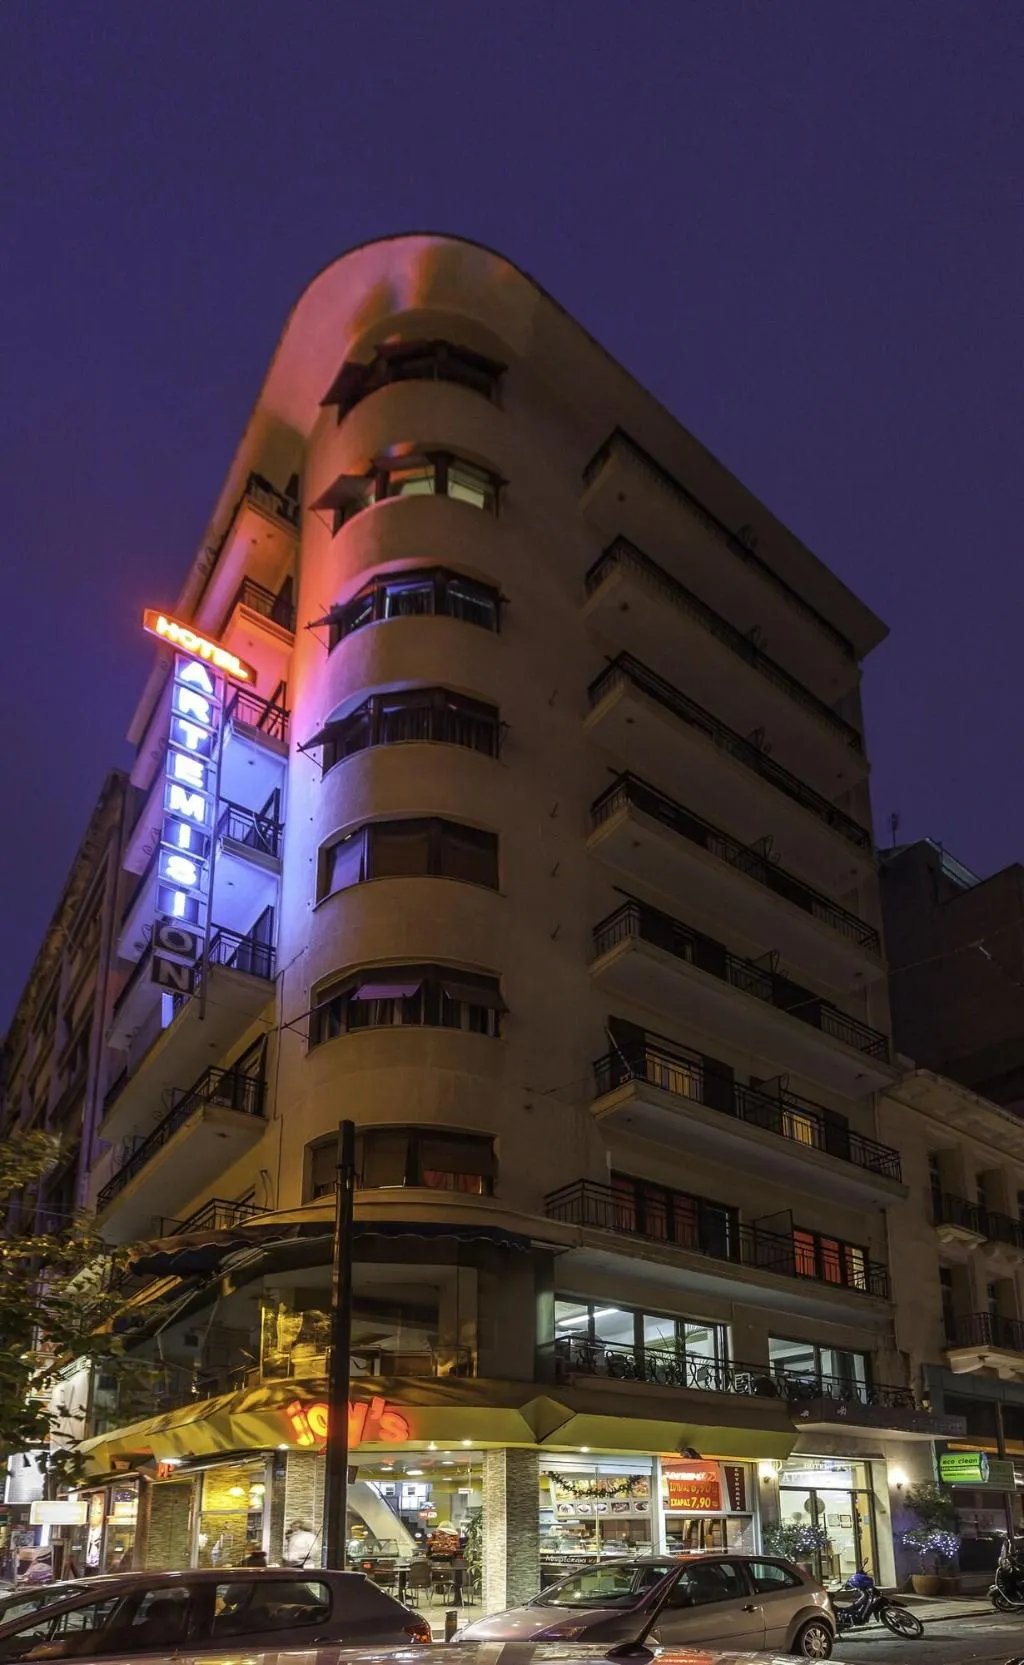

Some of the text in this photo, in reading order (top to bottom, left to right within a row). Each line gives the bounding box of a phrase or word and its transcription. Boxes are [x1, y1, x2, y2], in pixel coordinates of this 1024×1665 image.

[156, 615, 248, 678] HOTEL
[155, 660, 214, 990] ARTEMISION
[691, 1496, 711, 1508] 7,90
